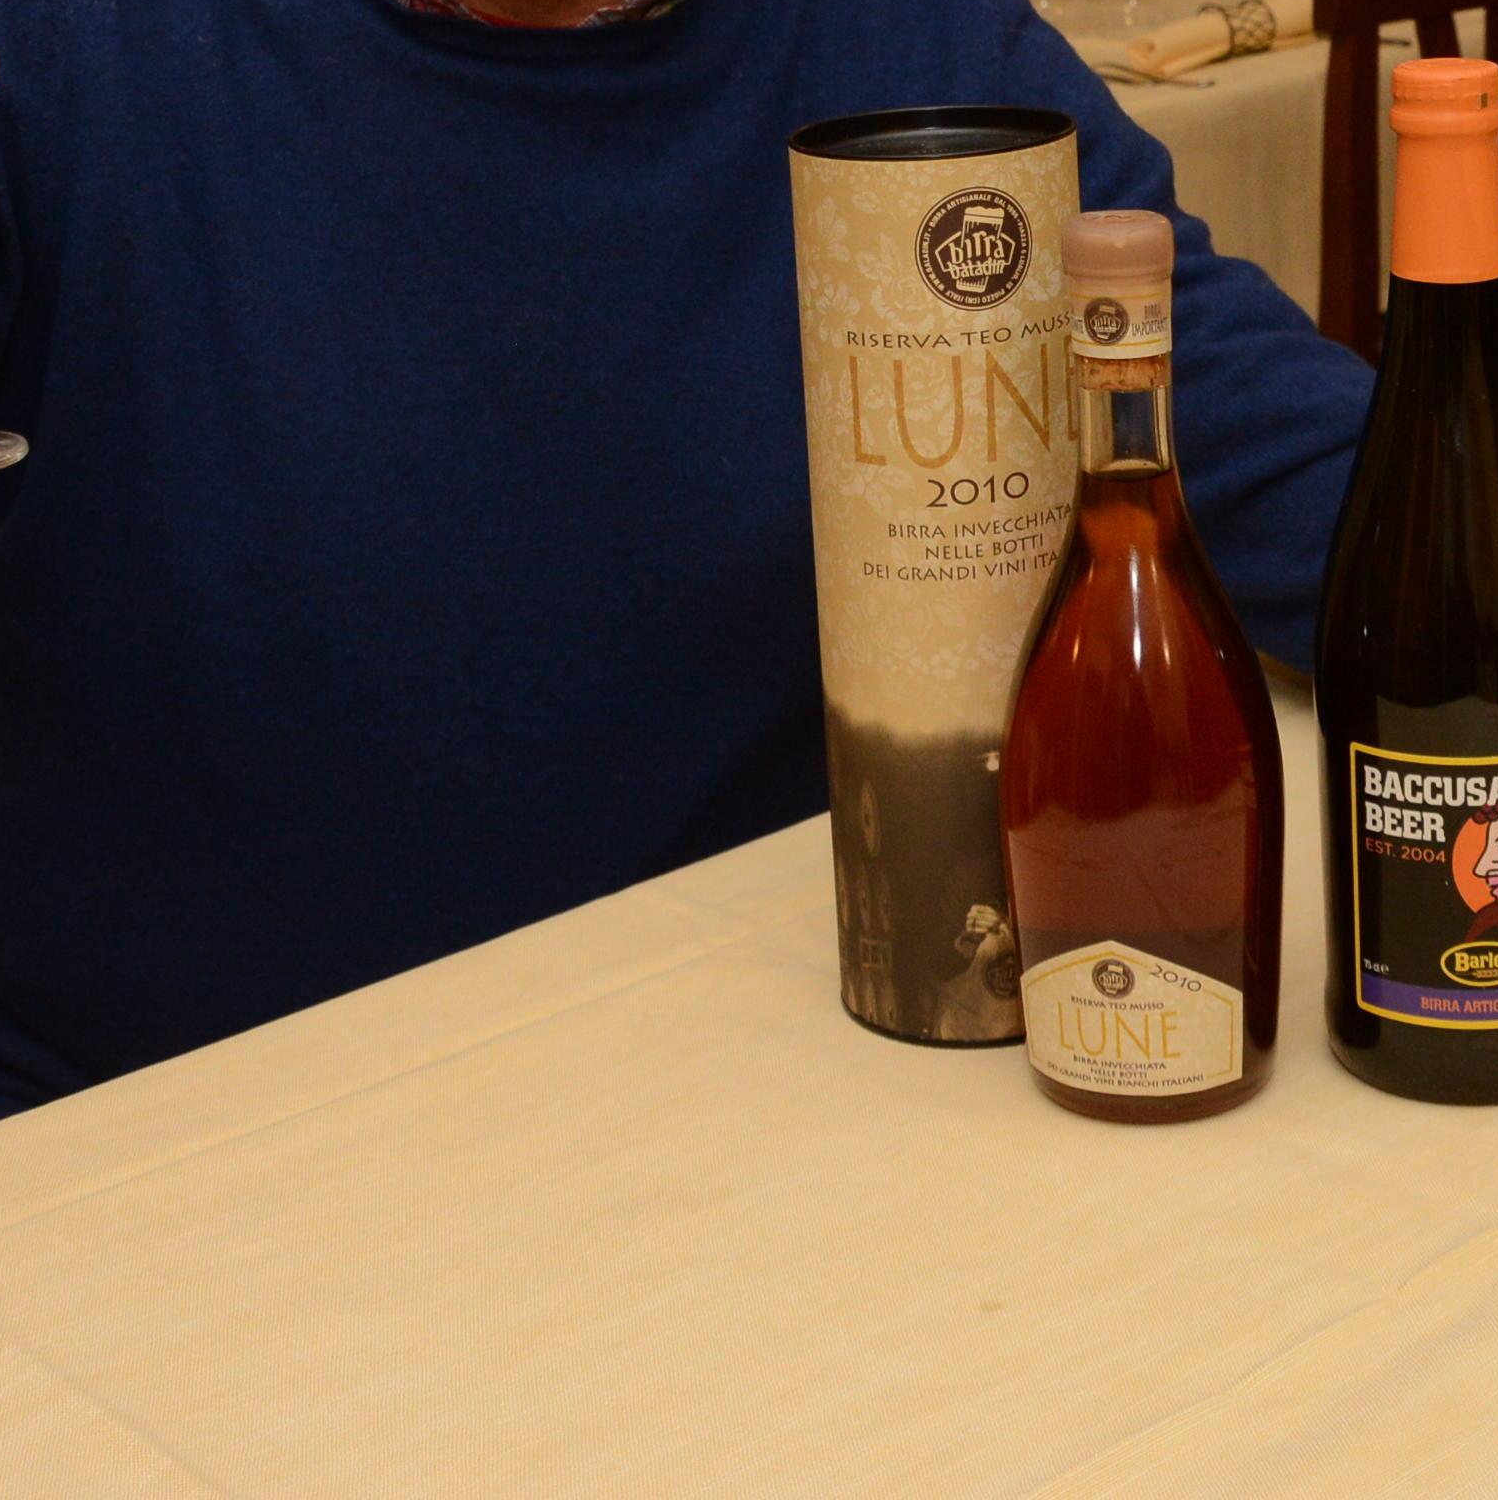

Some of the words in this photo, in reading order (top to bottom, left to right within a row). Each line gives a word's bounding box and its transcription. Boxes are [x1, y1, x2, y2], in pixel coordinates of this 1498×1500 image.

[847, 331, 951, 349] RISERVA
[960, 327, 1012, 347] TEO
[1021, 310, 1072, 338] MUSS
[926, 472, 1029, 508] 2010
[888, 522, 946, 539] BIRRA
[954, 502, 1072, 538] INVECCHIATA
[925, 543, 984, 561] NELLE
[992, 533, 1044, 556] BOTTI
[863, 561, 890, 579] DEI
[897, 565, 977, 582] GRANDI
[984, 558, 1027, 578] VINI
[1033, 551, 1060, 572] ITA
[1364, 801, 1446, 843] BEER
[1365, 836, 1398, 858] EST.
[1401, 846, 1446, 864] 2004
[1149, 963, 1202, 993] 2010
[1070, 995, 1107, 1009] RISERVA
[1109, 1002, 1127, 1011] TEO
[1129, 1001, 1165, 1011] MUSSO
[1420, 996, 1461, 1013] BIRRA
[1057, 1001, 1182, 1061] LUNE
[1073, 1054, 1099, 1067] BIRRA
[1100, 1060, 1167, 1070] INVECCHIATA
[1090, 1067, 1116, 1078] NELLE
[1119, 1070, 1148, 1079] BOTTI
[1059, 1067, 1092, 1083] GRANDI
[1093, 1076, 1115, 1087] VINI
[1117, 1079, 1159, 1088] BIANCHI
[1161, 1073, 1204, 1088] ITALIANI
